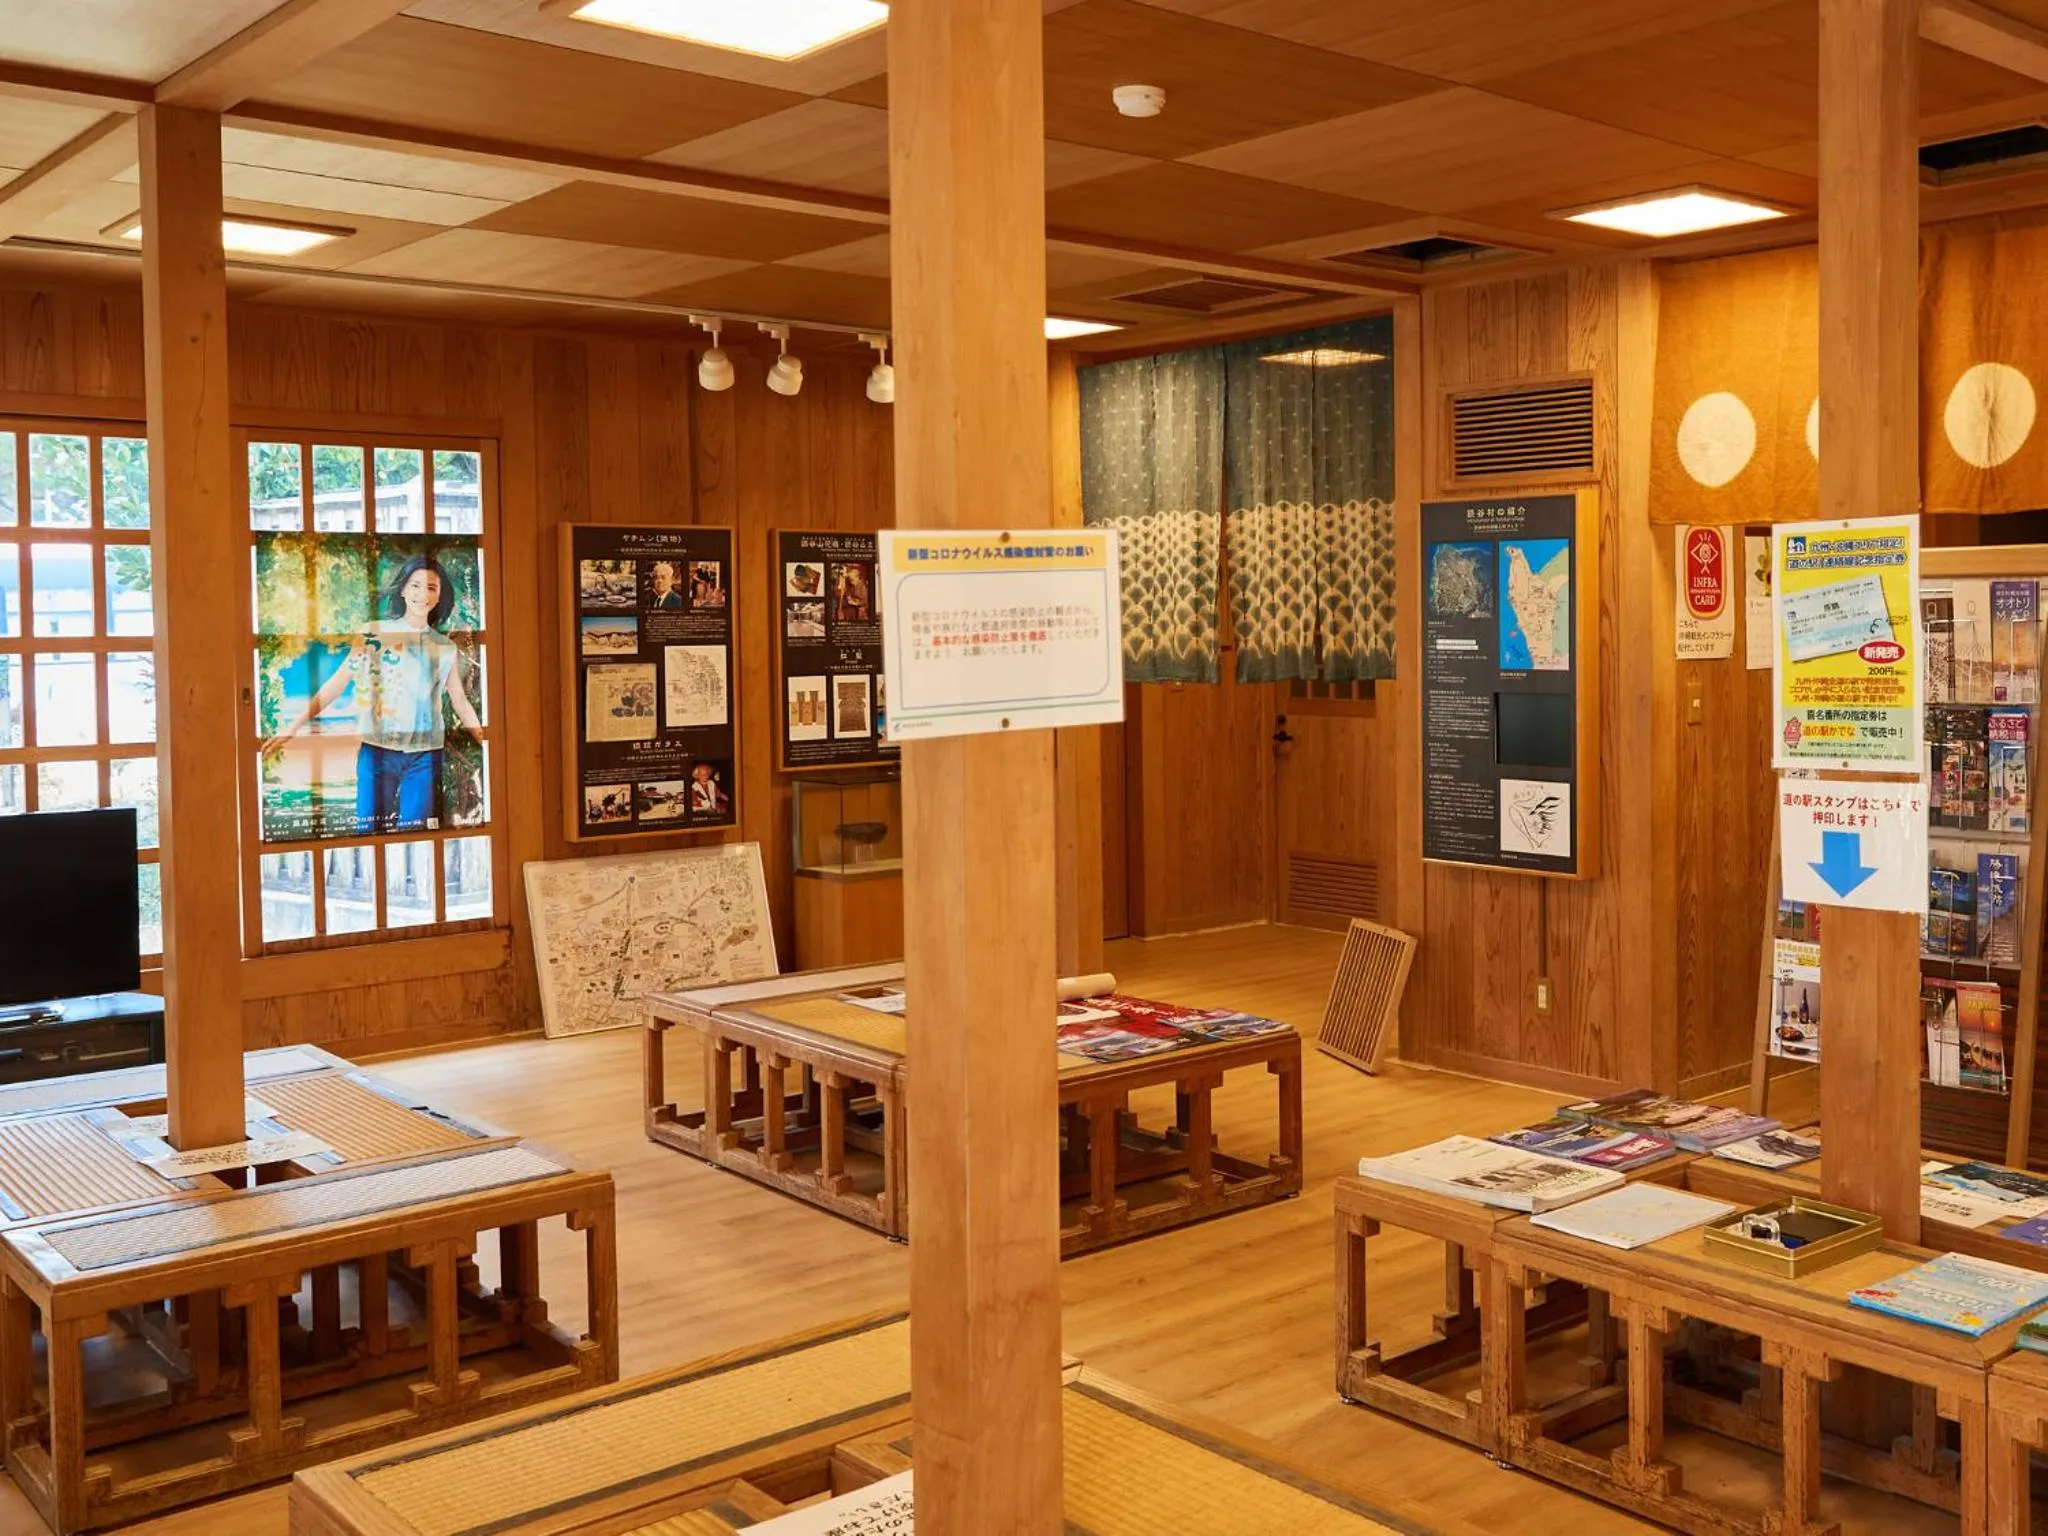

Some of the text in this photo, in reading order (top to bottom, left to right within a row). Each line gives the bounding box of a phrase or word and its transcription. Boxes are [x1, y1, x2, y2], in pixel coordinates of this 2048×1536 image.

[1693, 577, 1719, 588] INFRA
[1695, 595, 1716, 606] CARD
[1864, 645, 1900, 659] 新発売
[1868, 667, 1894, 676] 200円
[1812, 811, 1878, 828] 押印します!
